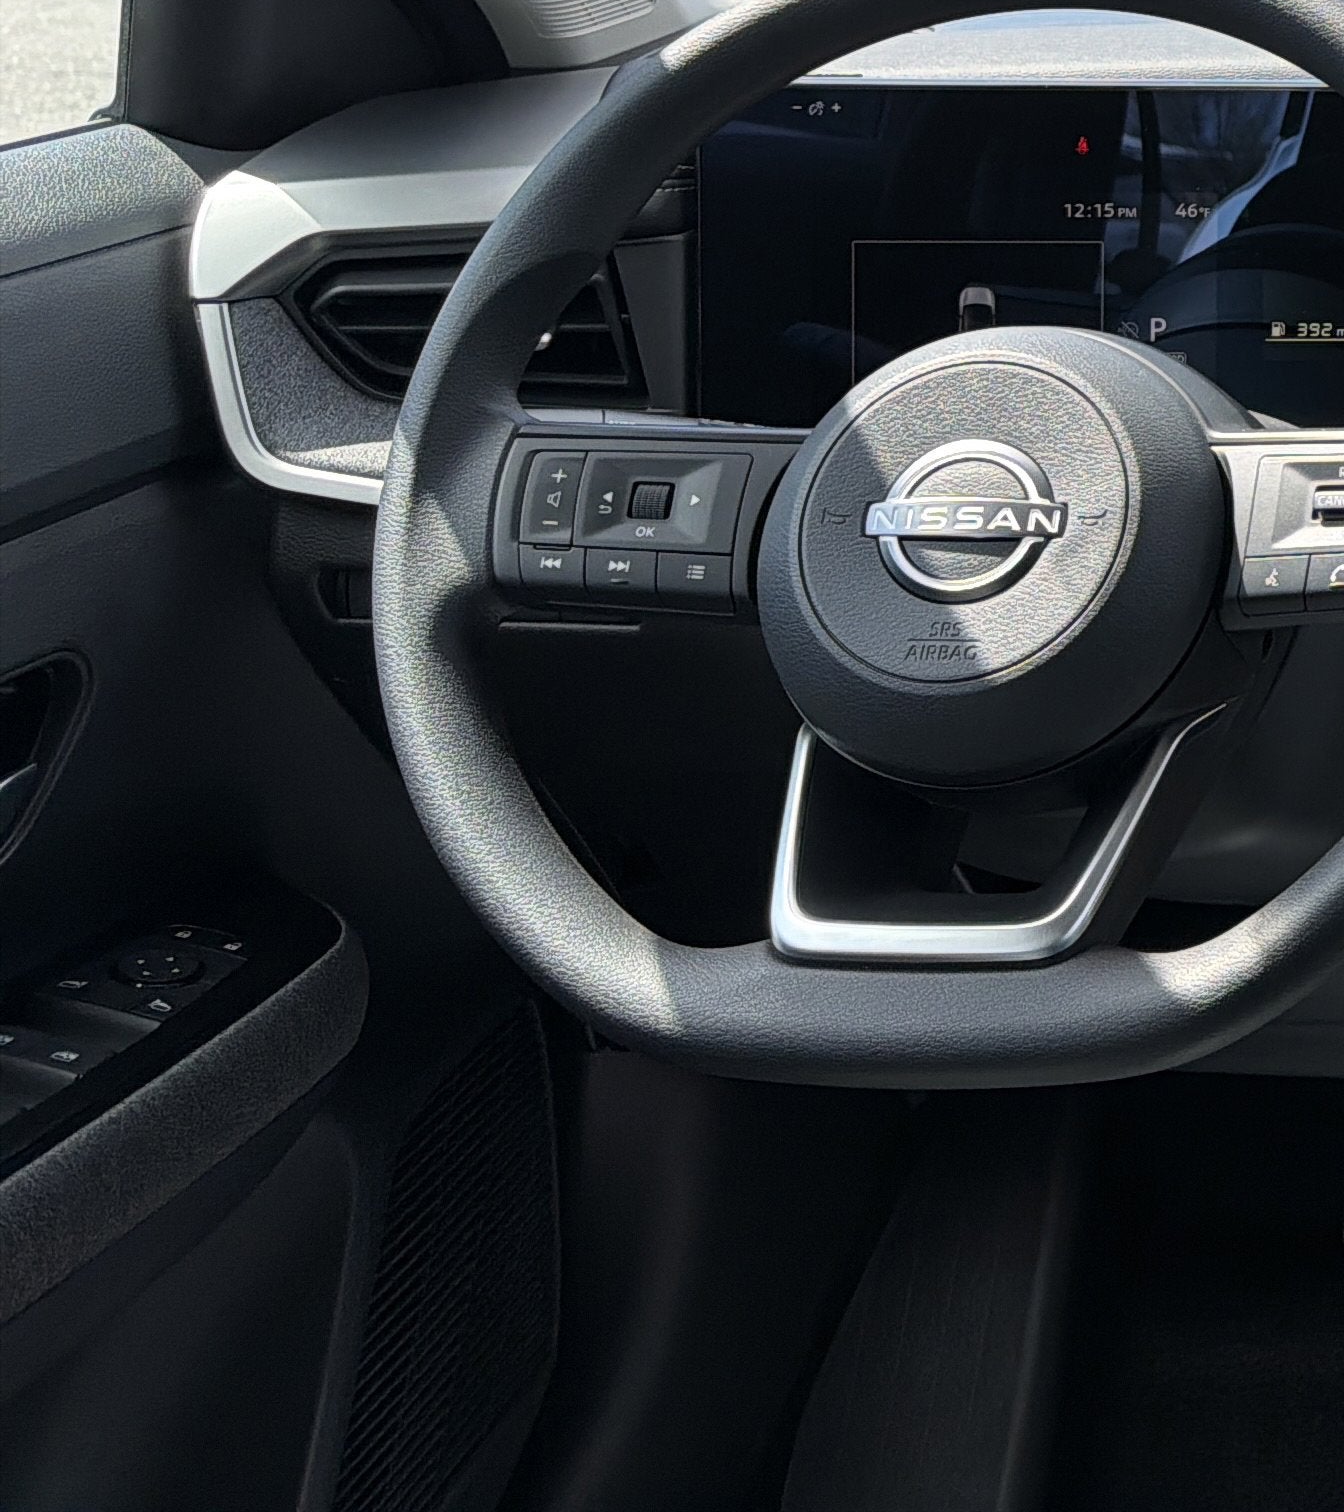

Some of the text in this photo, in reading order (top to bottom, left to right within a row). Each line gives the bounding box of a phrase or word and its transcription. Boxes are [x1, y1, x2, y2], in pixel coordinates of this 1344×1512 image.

[1064, 203, 1138, 218] 12:15 PM
[1150, 317, 1167, 342] P
[1296, 323, 1333, 337] 392
[871, 506, 1062, 534] NISSAN
[635, 526, 656, 538] OK
[928, 621, 961, 638] SRS
[903, 644, 978, 662] AIRBAG
